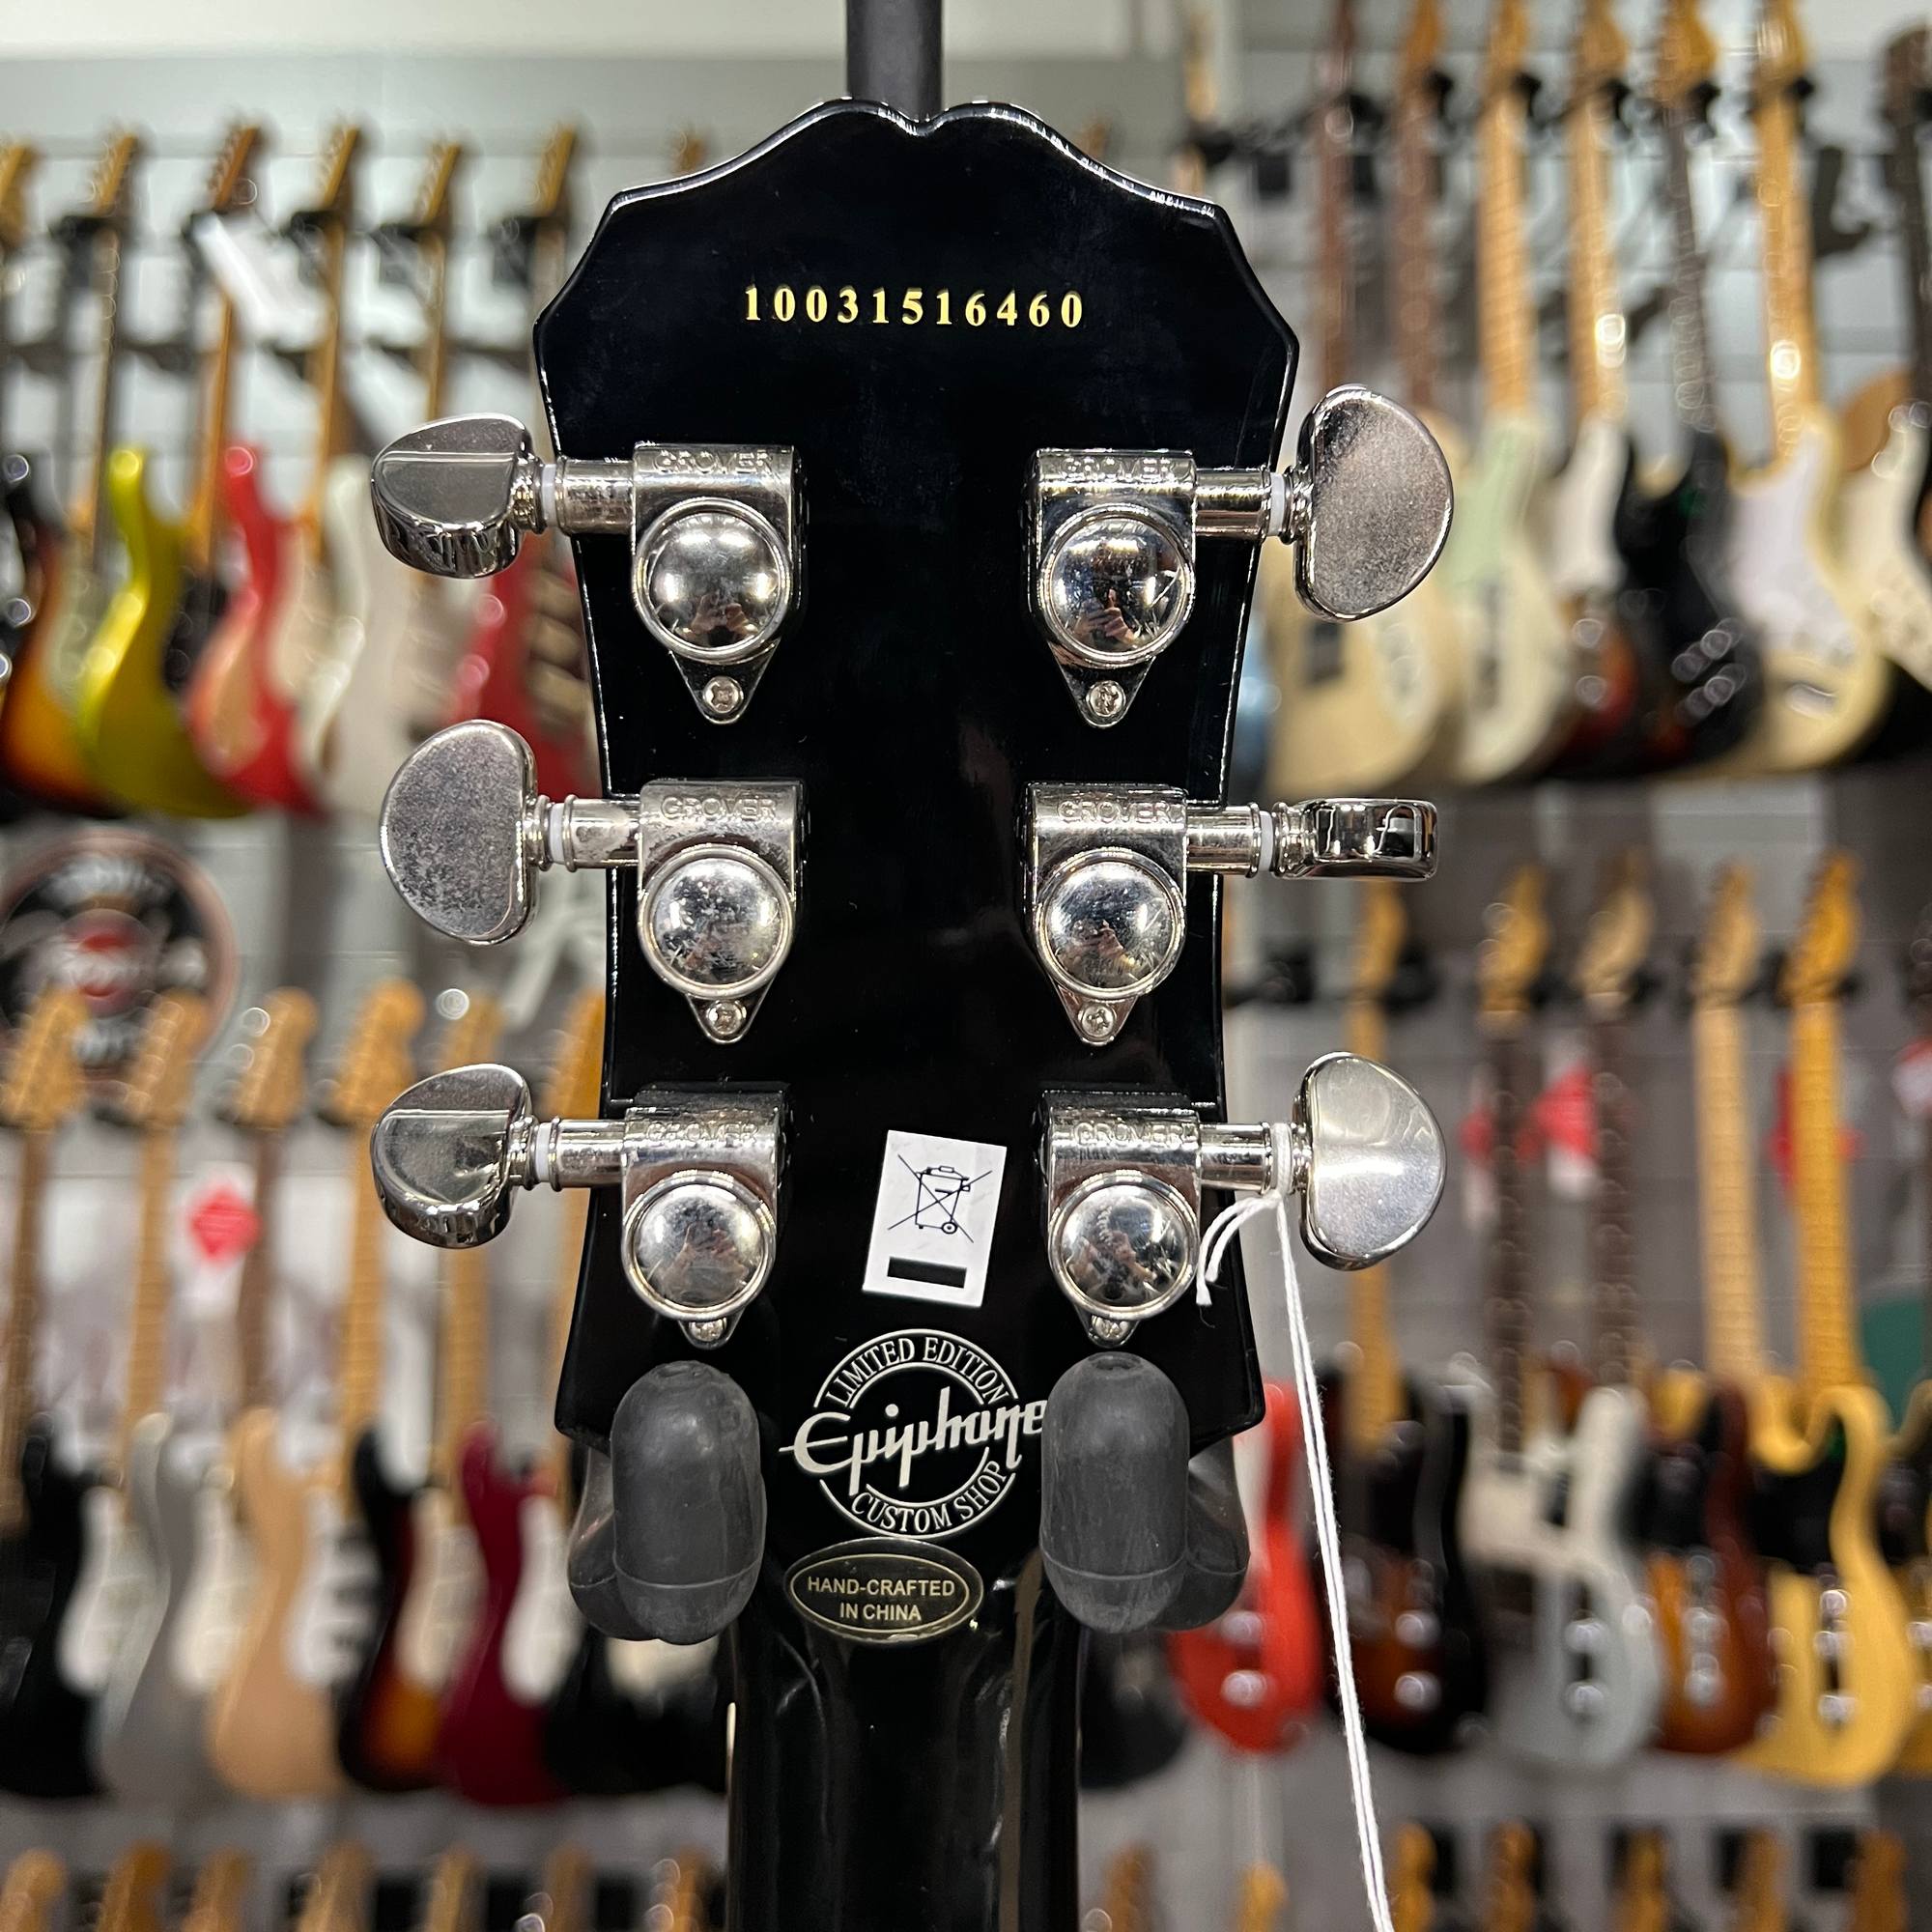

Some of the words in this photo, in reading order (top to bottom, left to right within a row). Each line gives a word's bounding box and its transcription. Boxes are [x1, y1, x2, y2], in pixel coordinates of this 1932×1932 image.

[745, 285, 1083, 327] 10031516460
[661, 796, 777, 821] GROVER
[1058, 800, 1171, 824] GROVER
[826, 1338, 915, 1407] LIMITED
[923, 1337, 1009, 1405] EDITION
[779, 1386, 1048, 1496] Epiphone
[850, 1492, 952, 1532] CUSTOM
[952, 1461, 1009, 1520] SHOP
[808, 1577, 955, 1596] HAND-CRAFTED
[839, 1603, 858, 1619] IN
[863, 1604, 922, 1621] CHINA
